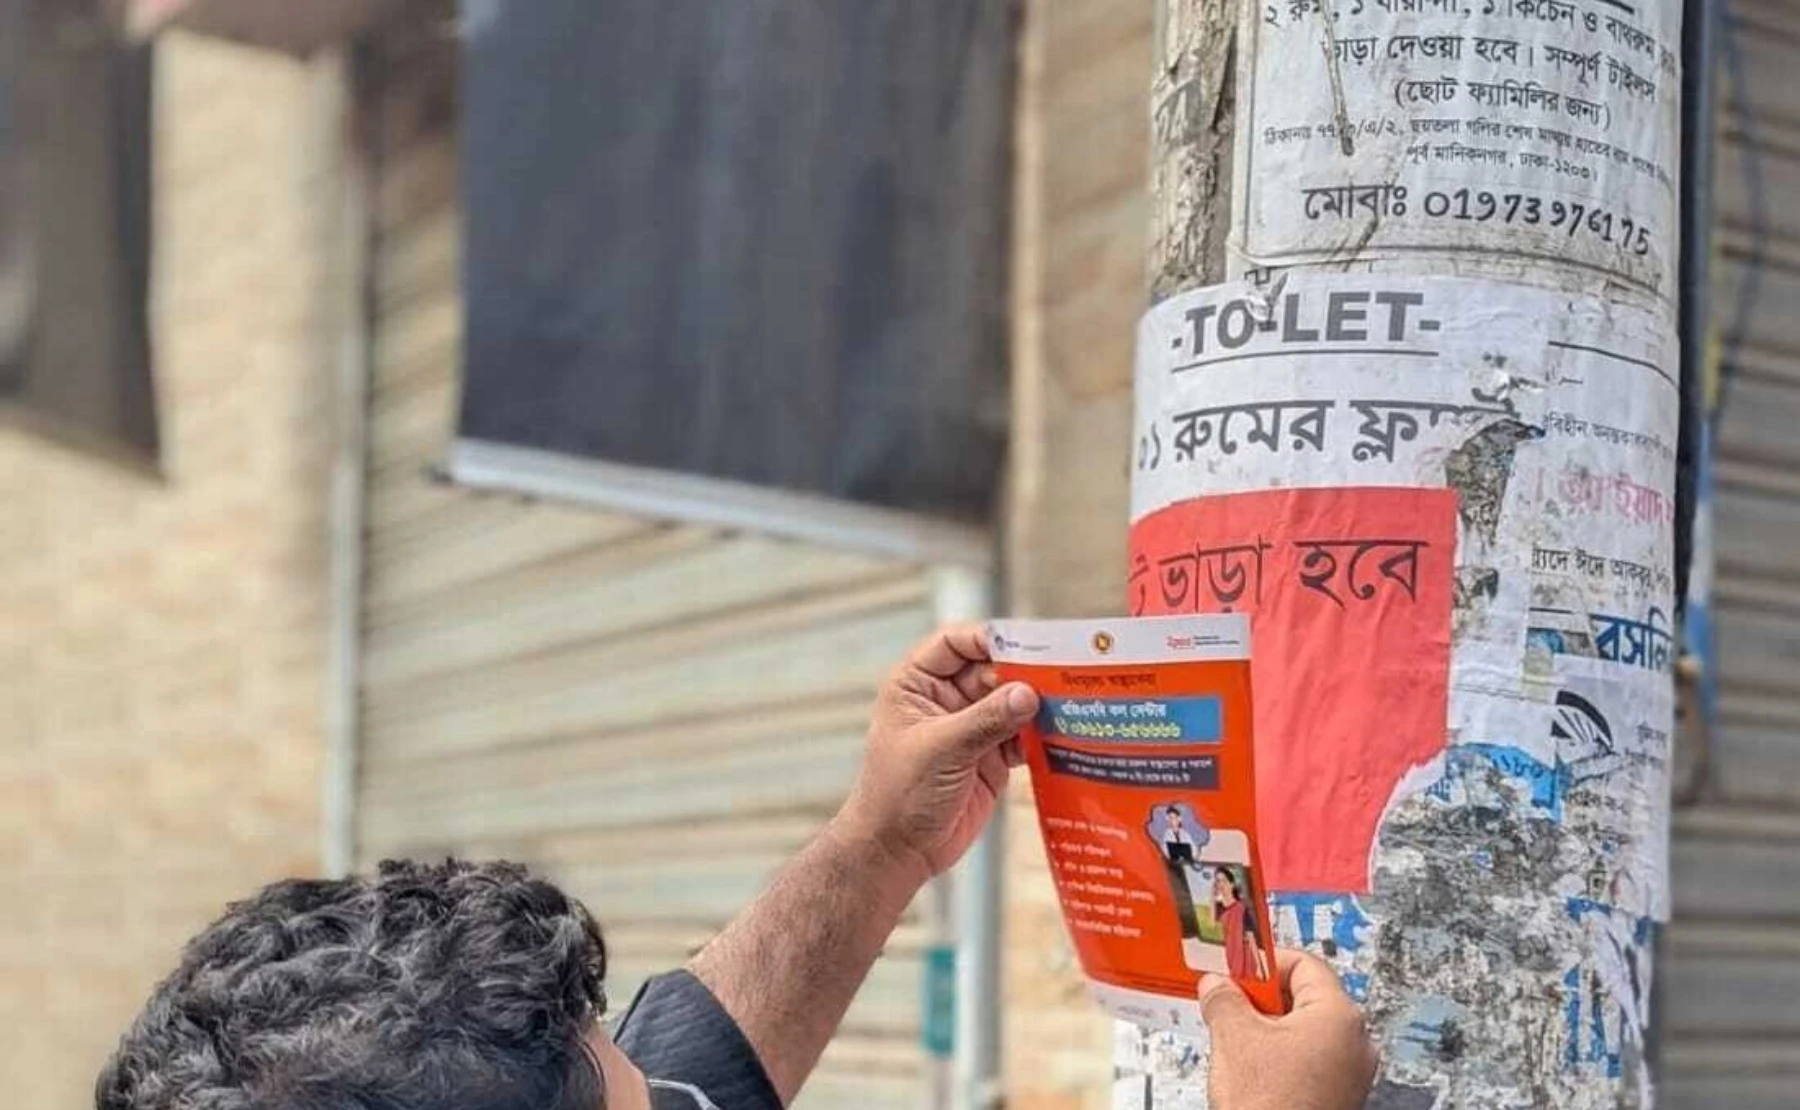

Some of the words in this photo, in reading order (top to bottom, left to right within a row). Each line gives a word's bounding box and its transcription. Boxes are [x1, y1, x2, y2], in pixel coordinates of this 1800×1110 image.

[1474, 36, 1518, 65] হবে
[1172, 399, 1335, 463] রুমের
[1158, 533, 1273, 614] ভাড়া
[1293, 537, 1431, 611] হবে
